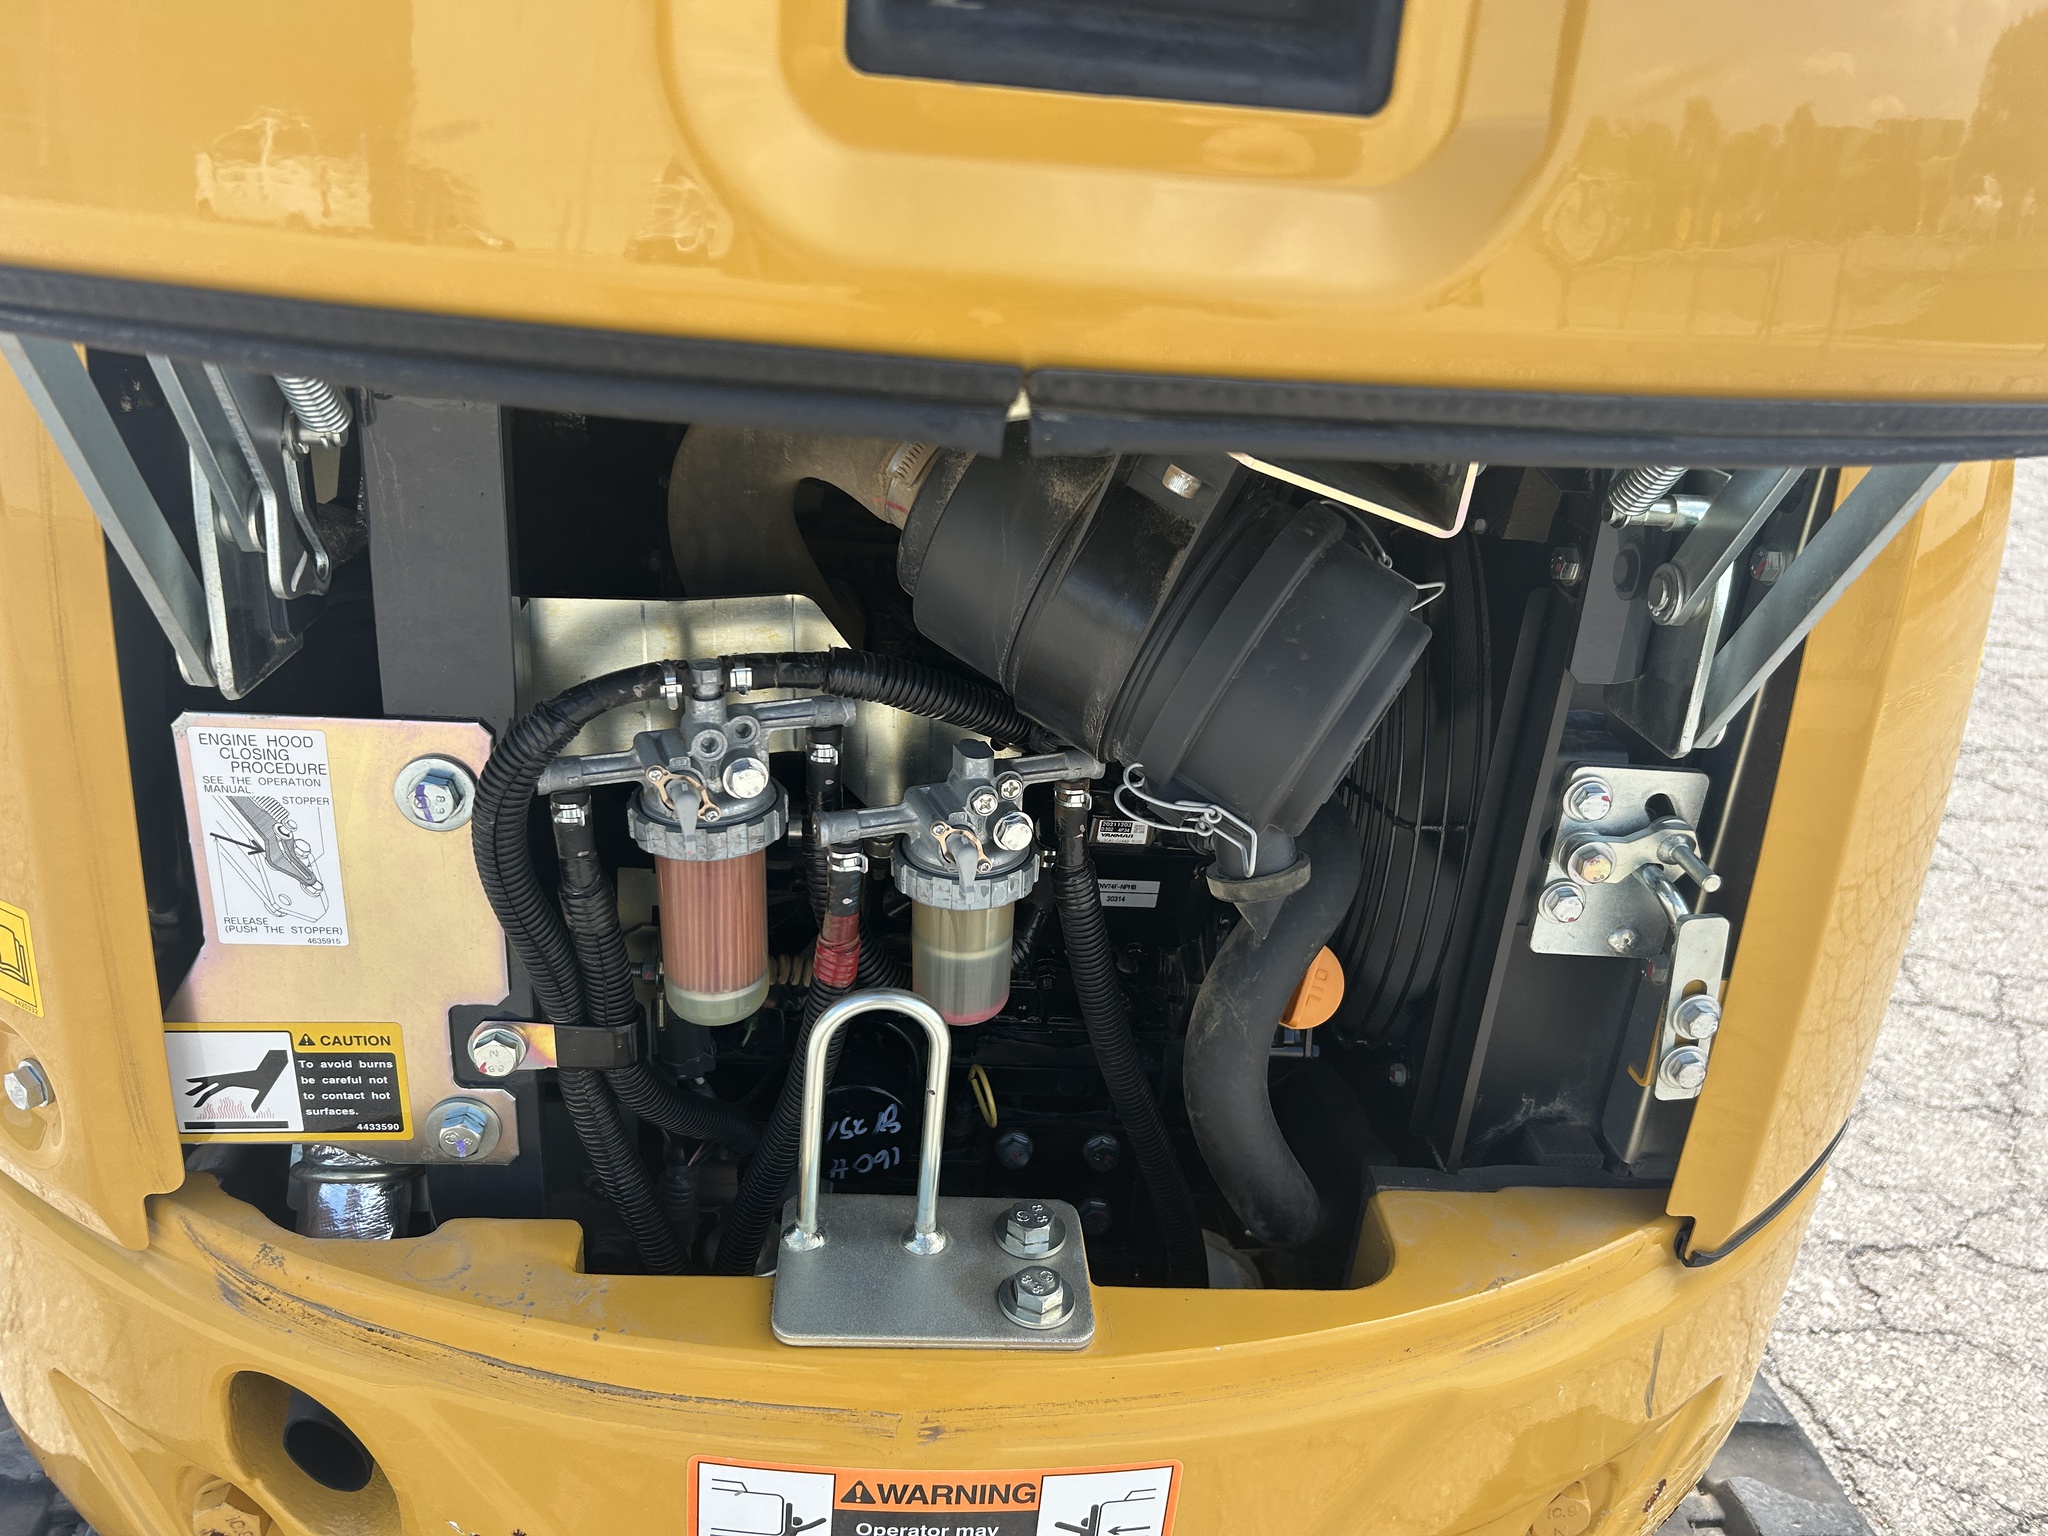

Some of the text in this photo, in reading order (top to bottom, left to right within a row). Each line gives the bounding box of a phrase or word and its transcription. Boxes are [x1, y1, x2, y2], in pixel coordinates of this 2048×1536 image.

[198, 733, 314, 748] ENGINE HOOD
[219, 747, 290, 761] CLOSING
[230, 761, 328, 776] PROCEDURE
[202, 775, 322, 787] SEE THE OPERATION
[282, 796, 330, 806] STOPPER
[223, 917, 269, 925] RELEASE
[264, 926, 285, 934] THE
[291, 926, 343, 935] STOPPER)
[1305, 968, 1328, 1006] OIL
[320, 1035, 391, 1046] CAUTION
[298, 1060, 393, 1069] To avoid burns
[301, 1076, 388, 1084] be careful not
[303, 1092, 391, 1100] to contact hot
[305, 1107, 359, 1116] surfaces.
[876, 1482, 1037, 1505] WARNING
[855, 1522, 1000, 1536] Operator may
